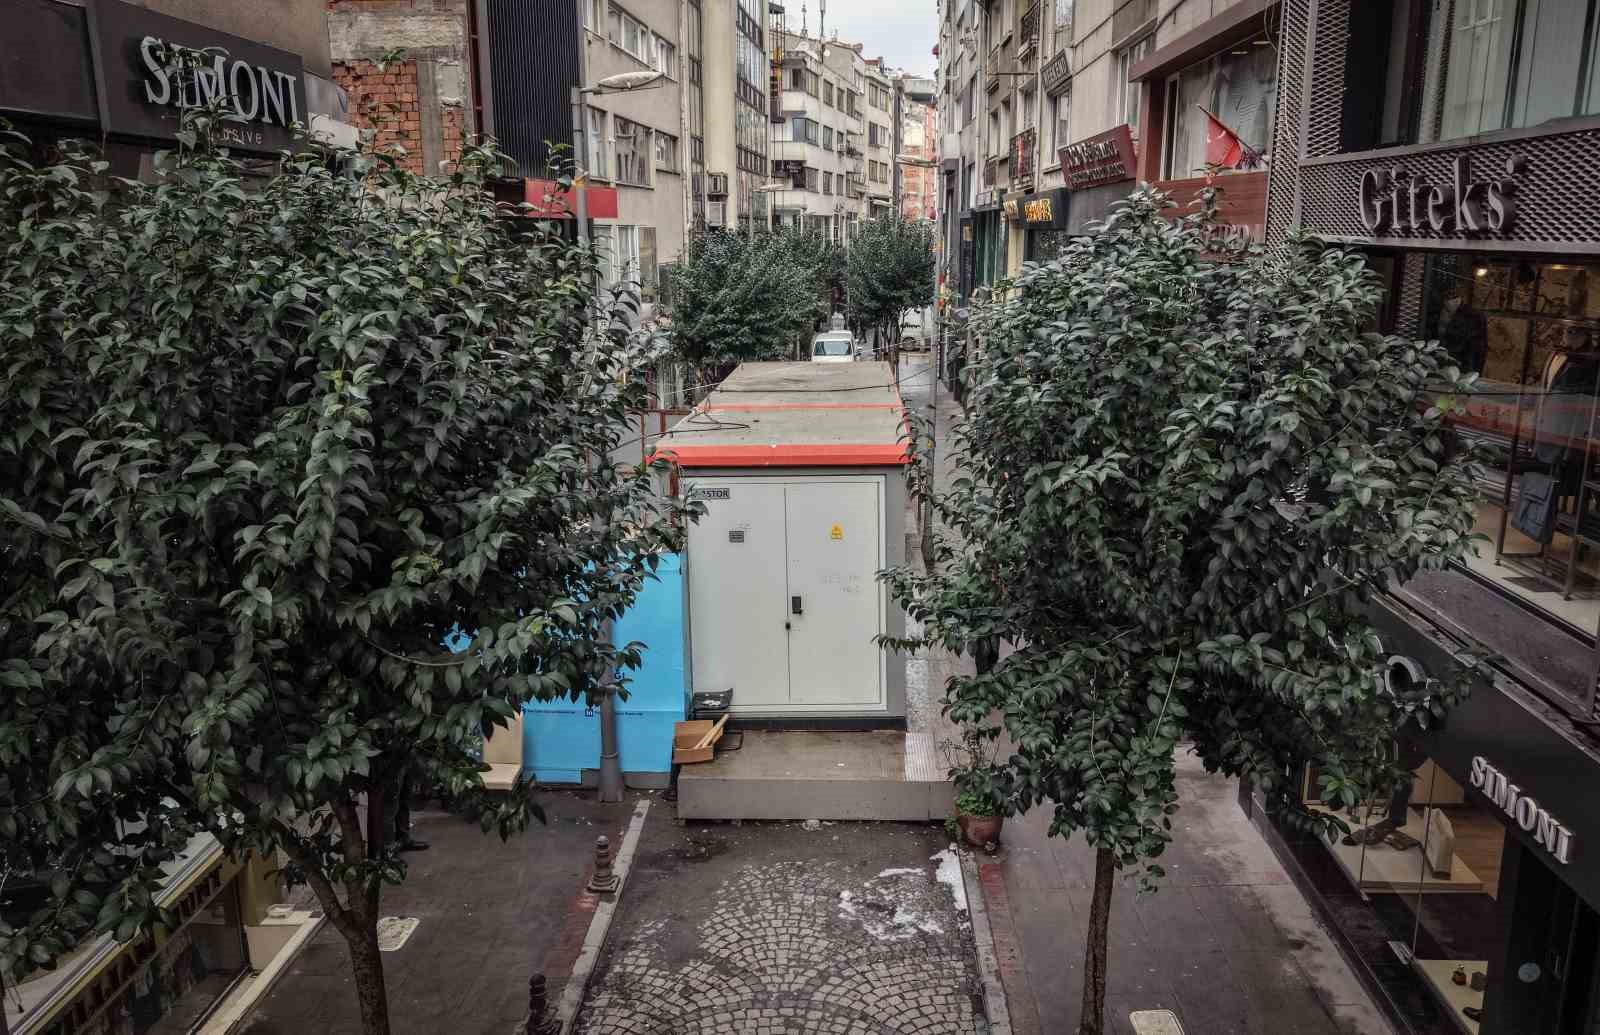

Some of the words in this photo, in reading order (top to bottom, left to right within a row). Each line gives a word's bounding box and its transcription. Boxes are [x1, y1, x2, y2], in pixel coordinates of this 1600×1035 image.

[141, 36, 298, 125] SIMONI
[1359, 153, 1508, 231] Giteks
[1469, 755, 1574, 865] SIMONI
